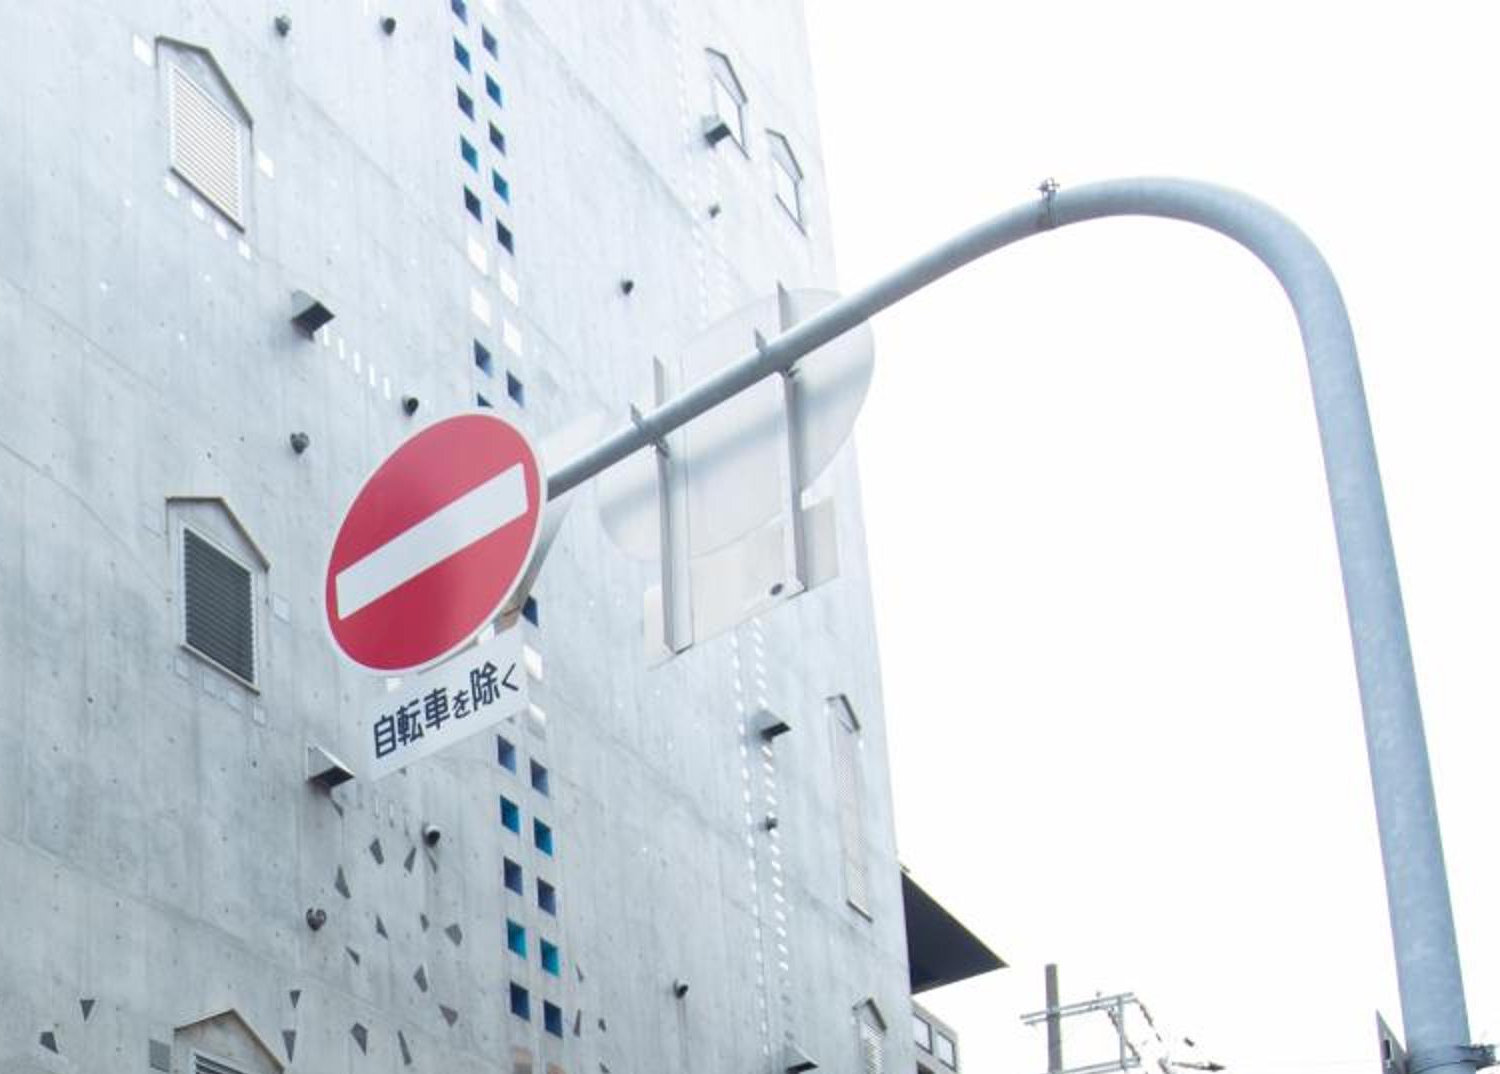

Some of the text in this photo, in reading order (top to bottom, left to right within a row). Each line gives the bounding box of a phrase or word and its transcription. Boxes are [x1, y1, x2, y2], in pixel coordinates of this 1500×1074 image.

[373, 661, 520, 760] 自転車を除く
